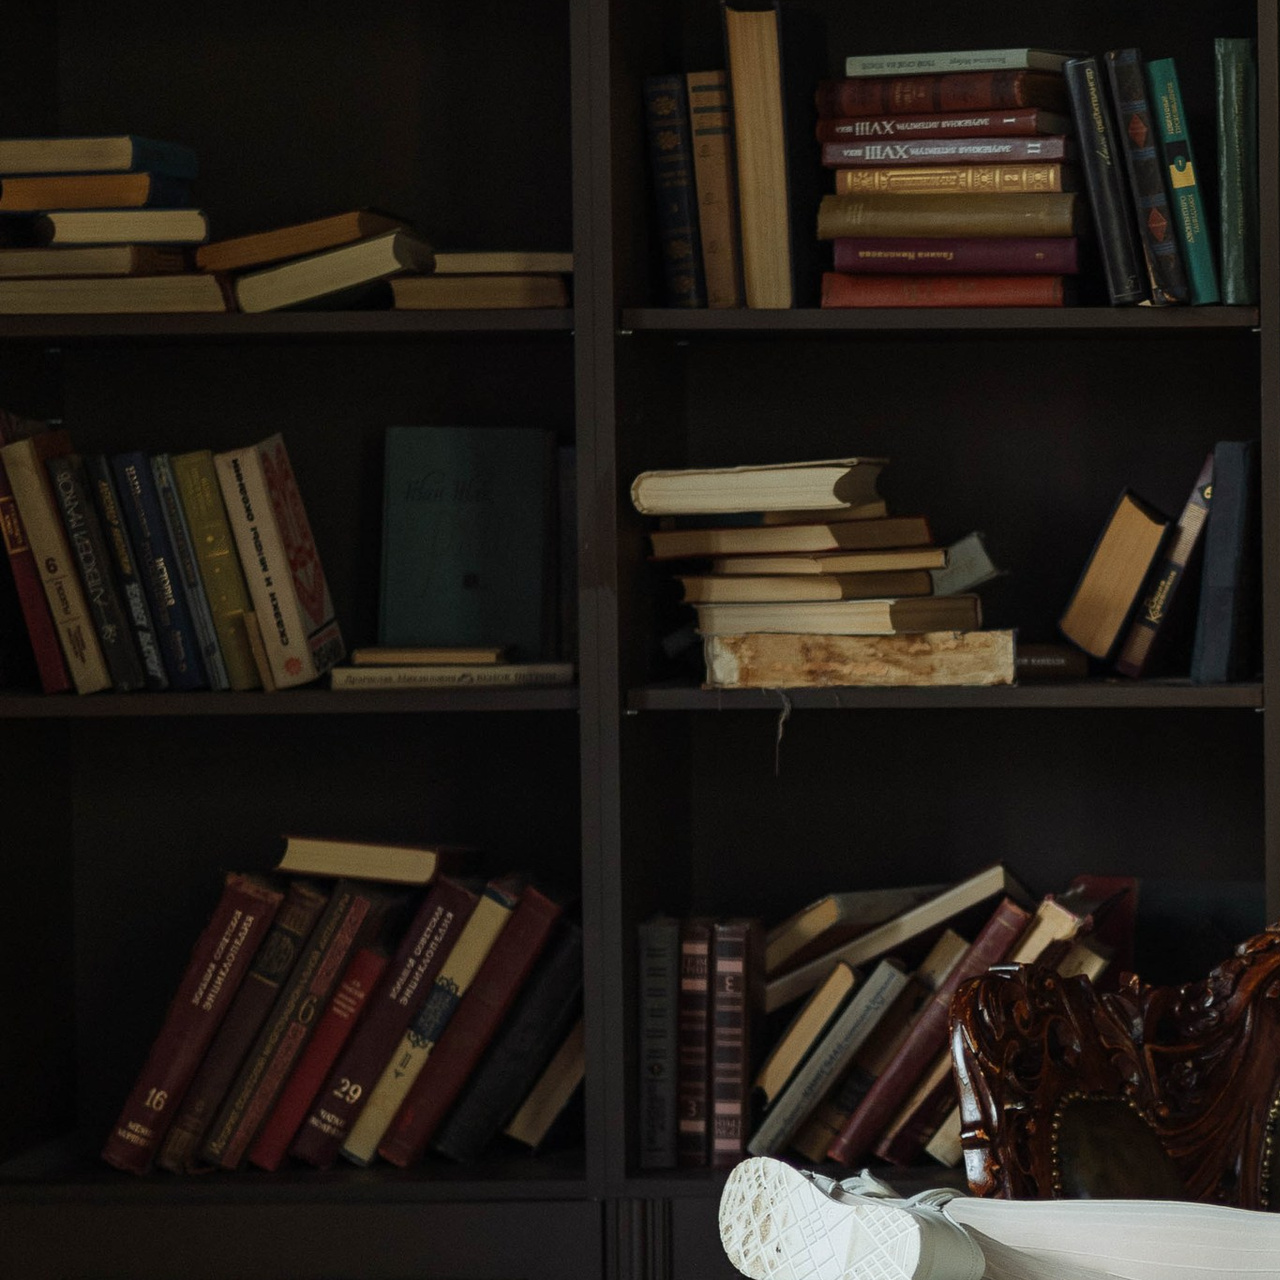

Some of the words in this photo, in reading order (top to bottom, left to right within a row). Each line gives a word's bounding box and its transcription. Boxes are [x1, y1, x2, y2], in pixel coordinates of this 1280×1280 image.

[855, 120, 896, 136] XVIII
[942, 117, 990, 128] ЗАРУБЕЖНАЯ
[865, 145, 909, 160] XVIII
[959, 144, 1012, 154] ЗАРУБЕЖНАЯ
[56, 470, 84, 529] МАРКОВ
[73, 530, 105, 604] АЛЕКСЕЙ
[192, 961, 217, 1007] БОЛЬШАЯ
[213, 909, 243, 961] СОВЕТСКАЯ
[202, 915, 255, 1012] ЭНЦИКЛОПЕДИЯ
[389, 957, 417, 1001] БОЛЬШАЯ
[413, 905, 444, 957] СОВЕТСКАЯ
[399, 911, 455, 1006] ЭНЦИКЛОПЕДИЯ
[144, 1086, 168, 1111] 16
[332, 1077, 363, 1105] 29
